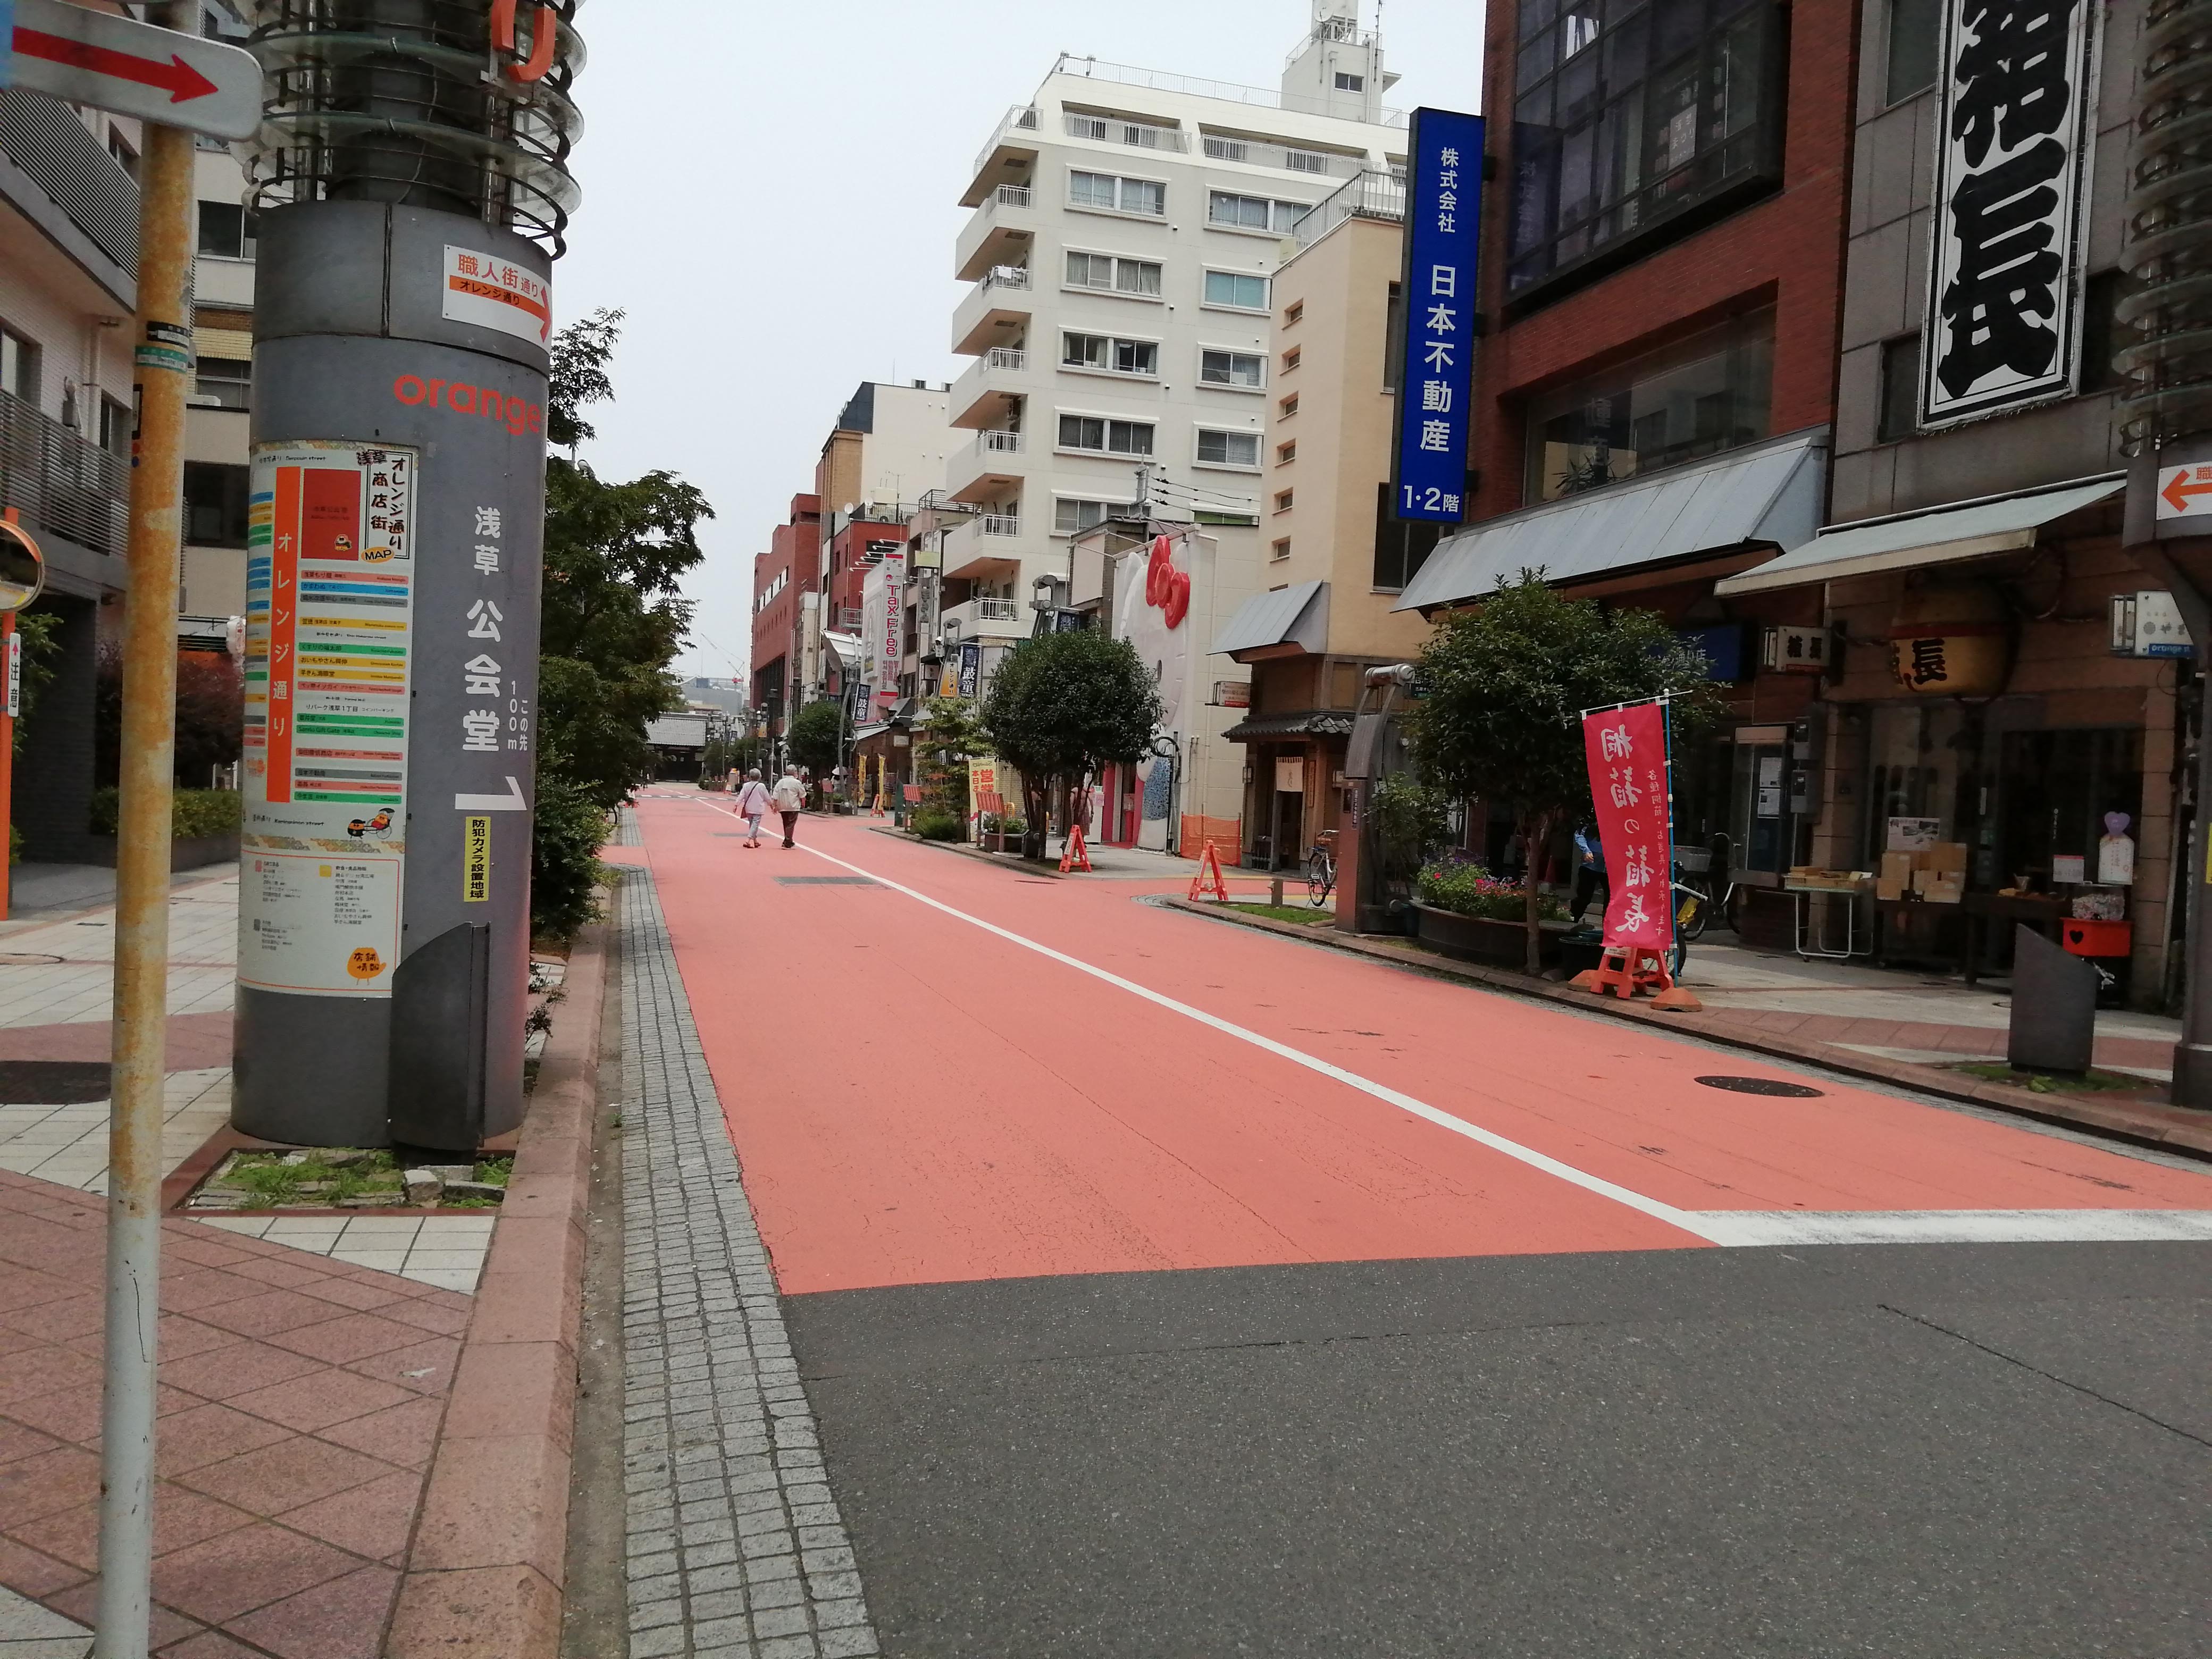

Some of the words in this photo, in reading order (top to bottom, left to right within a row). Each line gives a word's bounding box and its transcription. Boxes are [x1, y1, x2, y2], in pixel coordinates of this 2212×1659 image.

[1437, 147, 1459, 234] 株式会社
[458, 254, 538, 297] 職人街通り
[459, 280, 520, 305] オレンジ通り
[1419, 264, 1457, 453] 日本不動産
[394, 374, 541, 435] orange
[356, 450, 388, 466] 浅草
[371, 471, 389, 530] 商店街
[389, 457, 406, 550] オレンジ通り
[364, 549, 392, 561] MAP
[886, 585, 900, 615] Tax
[273, 533, 292, 737] オレンジ通り
[463, 506, 503, 751] 浅草公会堂
[886, 618, 899, 657] Free
[10, 662, 19, 708] 注意
[520, 699, 528, 751] この先
[470, 819, 486, 899] 防犯カメラ設置地域
